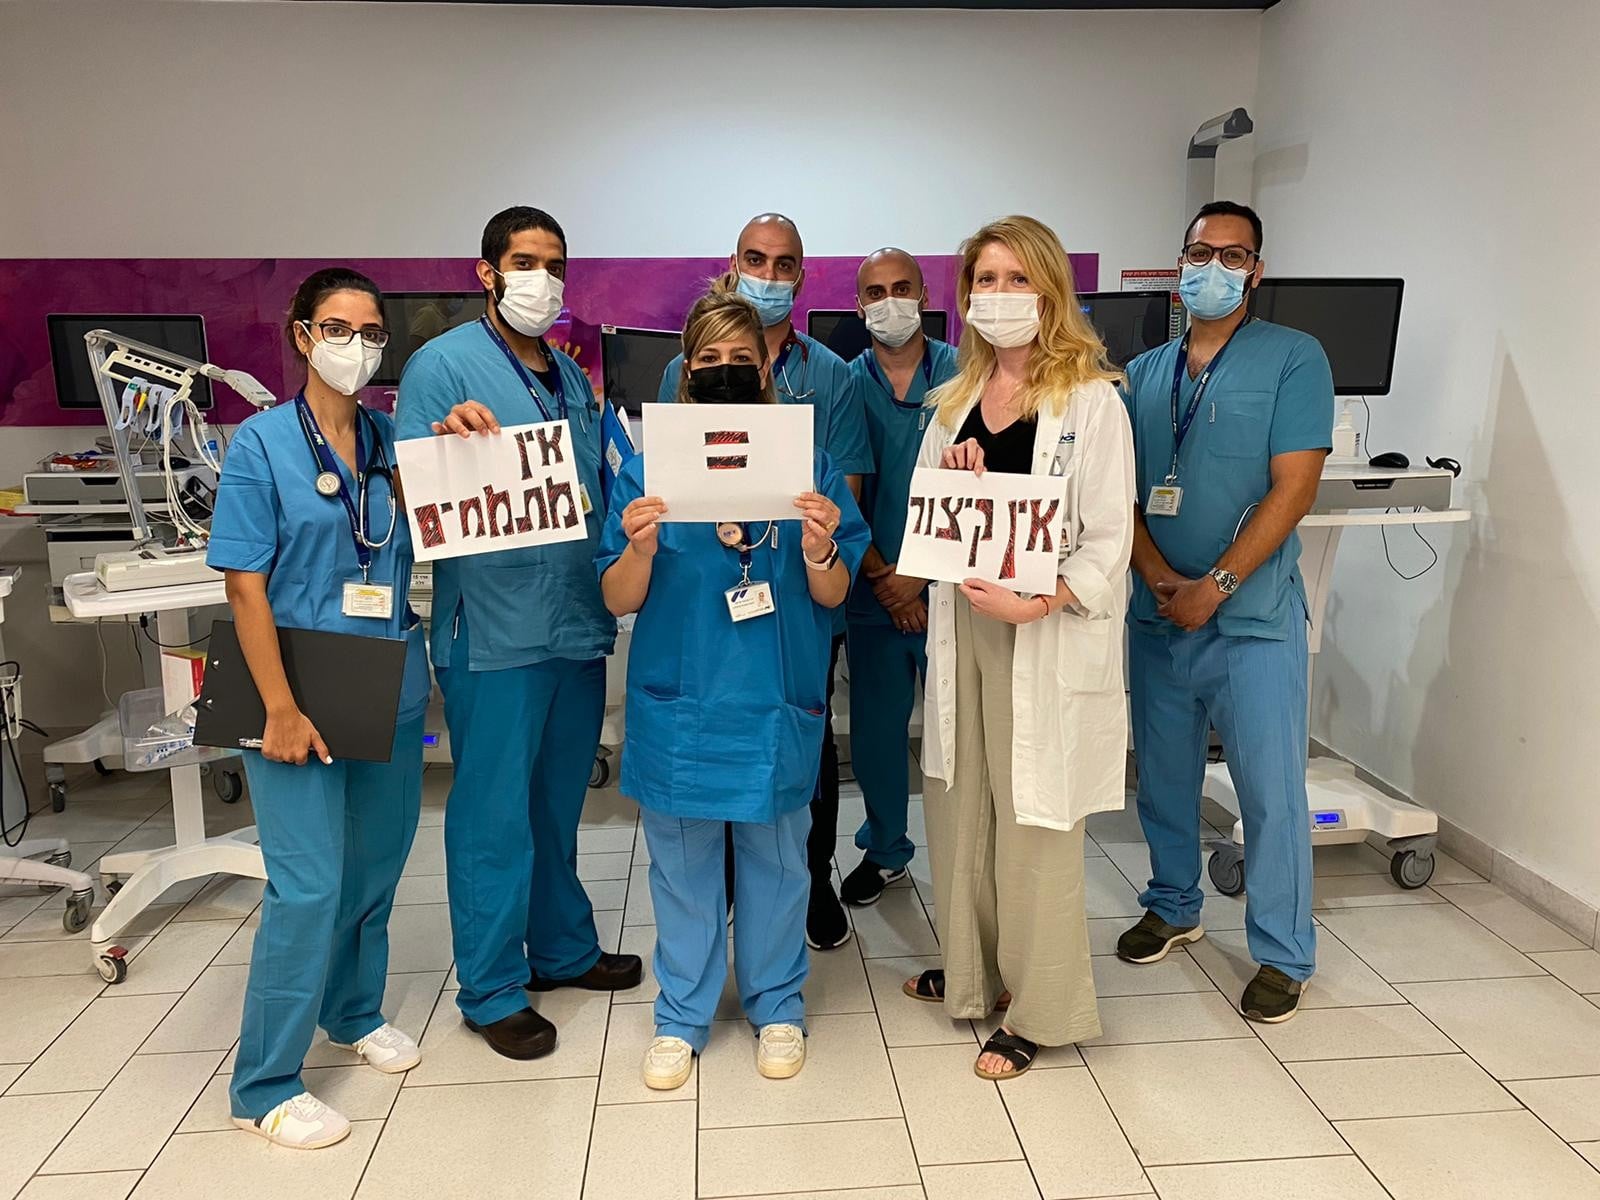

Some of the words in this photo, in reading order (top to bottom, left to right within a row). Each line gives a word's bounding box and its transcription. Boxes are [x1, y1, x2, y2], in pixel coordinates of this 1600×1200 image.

[513, 425, 564, 481] אין
[414, 476, 579, 549] מתמחים
[910, 496, 994, 568] קיצור
[998, 498, 1060, 580] אין
